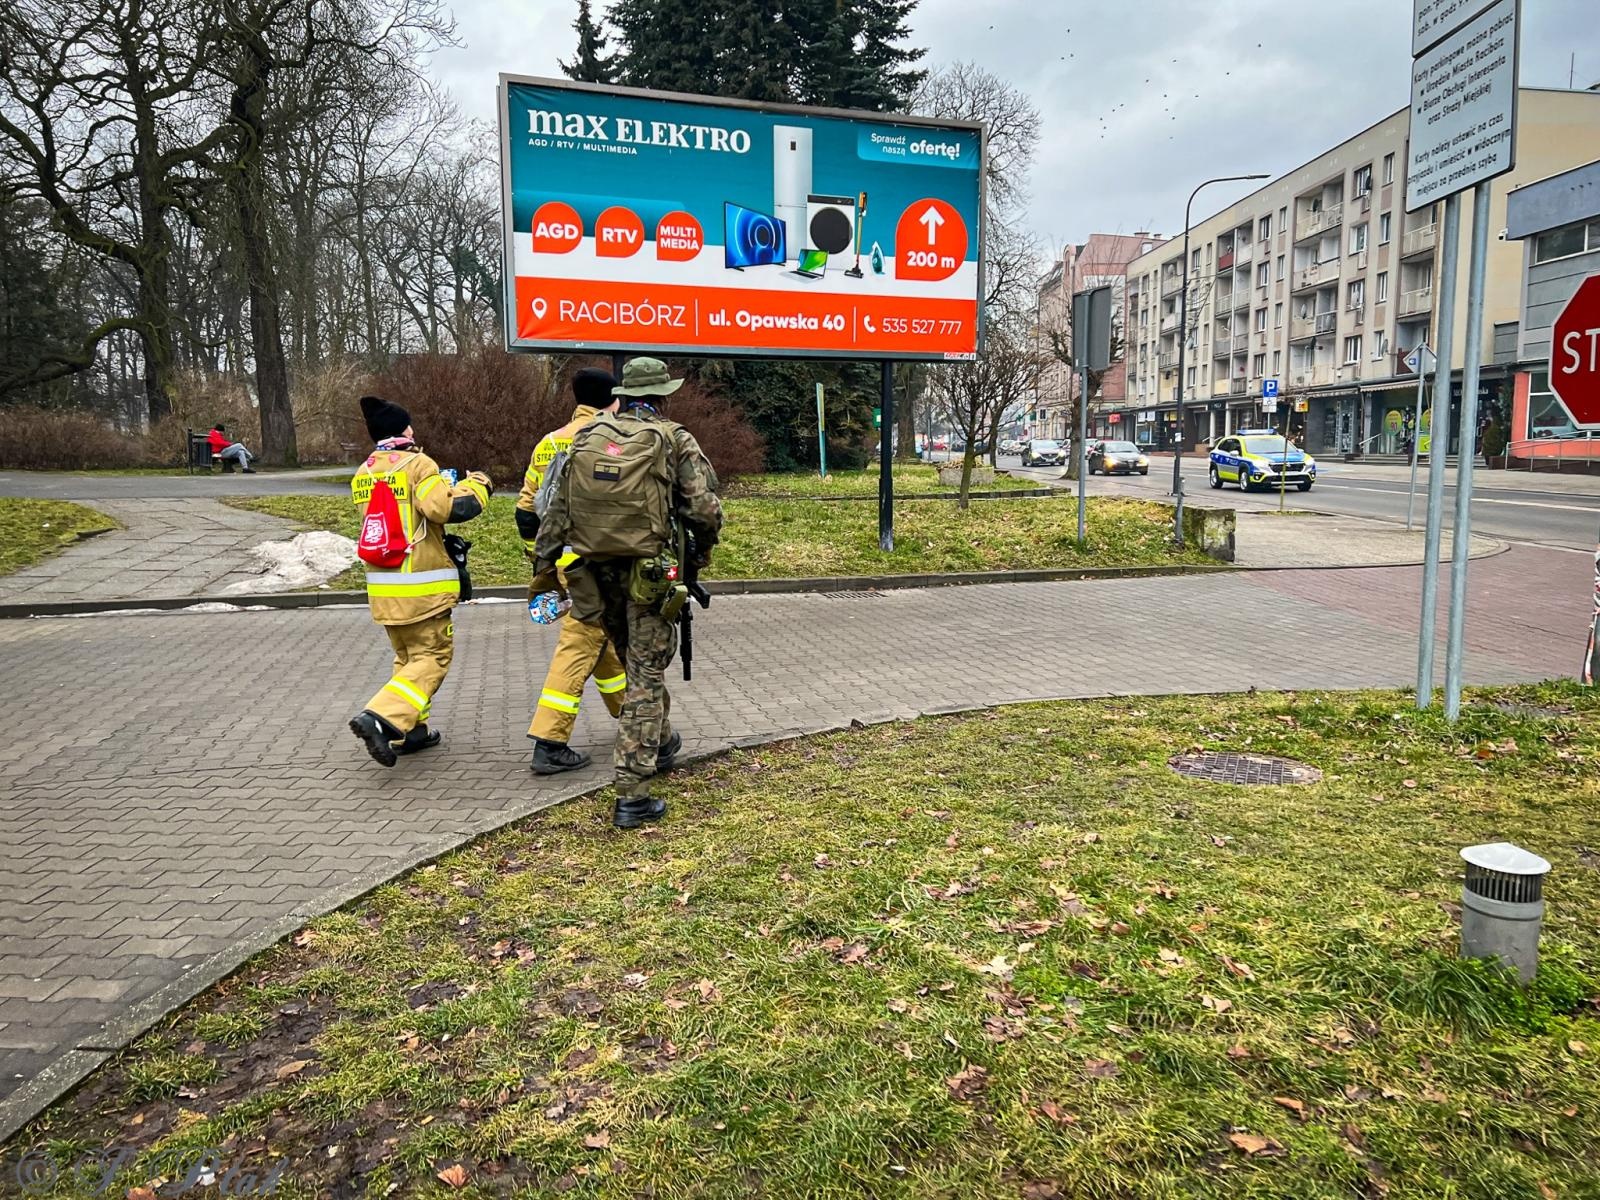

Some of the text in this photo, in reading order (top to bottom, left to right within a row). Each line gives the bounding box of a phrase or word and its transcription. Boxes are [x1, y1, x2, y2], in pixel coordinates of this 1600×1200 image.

[1433, 16, 1438, 25] w
[1414, 8, 1514, 84] Karty parkingowe można pobrać
[1426, 70, 1451, 92] Urzędzie
[1452, 57, 1473, 77] Miasta
[1475, 37, 1504, 62] Racibórz
[1423, 95, 1441, 112] Biurze
[1442, 76, 1467, 99] Obsługi
[1468, 55, 1506, 84] Interesanta
[1428, 79, 1491, 125] oraz Straży Miejskiej
[527, 108, 751, 154] max ELEKTRO
[871, 132, 906, 145] Sprawdź
[1415, 113, 1504, 165] Karty należy ustawić na czas
[528, 138, 548, 147] AGD
[557, 140, 575, 149] RTV
[583, 143, 637, 155] MULTIMEDIA
[882, 138, 960, 160] naszą ofertę!
[1407, 164, 1434, 185] przyjazdu
[1439, 147, 1466, 169] umieścić
[1474, 128, 1511, 152] widocznym
[1416, 152, 1497, 197] miejscu za przednią szybą
[534, 221, 579, 240] AGD
[602, 227, 638, 244] RTV
[660, 225, 697, 239] MULTI
[660, 238, 700, 251] MEDIA
[906, 250, 956, 269] 200 m
[559, 298, 687, 327] RACIBÓRZ
[708, 309, 846, 332] ul. Opawska 40
[882, 317, 962, 336] 535 527 777
[1561, 328, 1600, 374] ST
[1266, 381, 1276, 392] P
